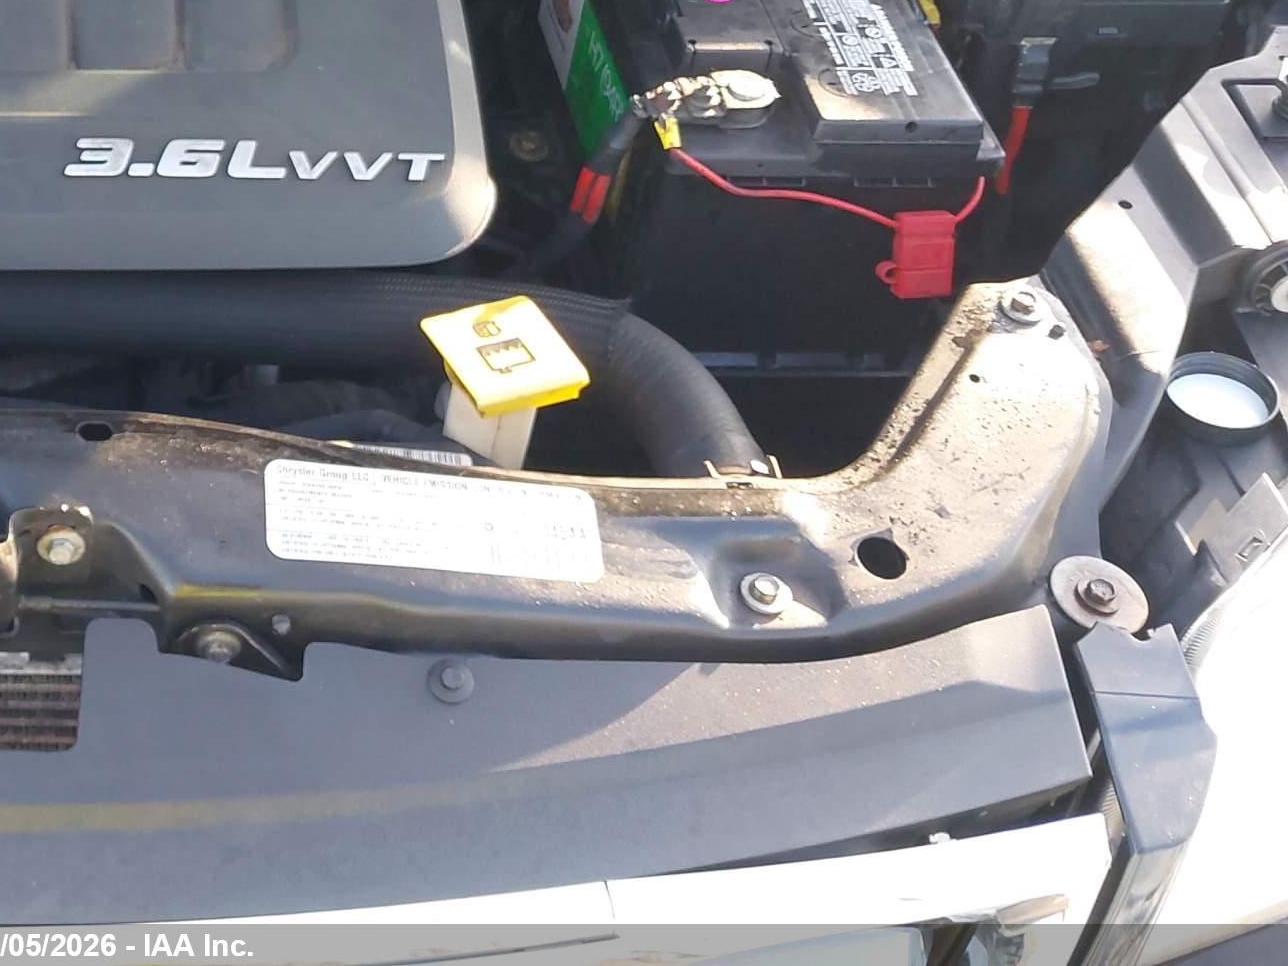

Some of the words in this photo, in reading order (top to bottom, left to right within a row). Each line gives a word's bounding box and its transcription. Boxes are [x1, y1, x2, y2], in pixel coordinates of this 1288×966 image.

[276, 464, 316, 480] Chrysler
[319, 468, 349, 483] Group
[350, 471, 369, 482] LLC
